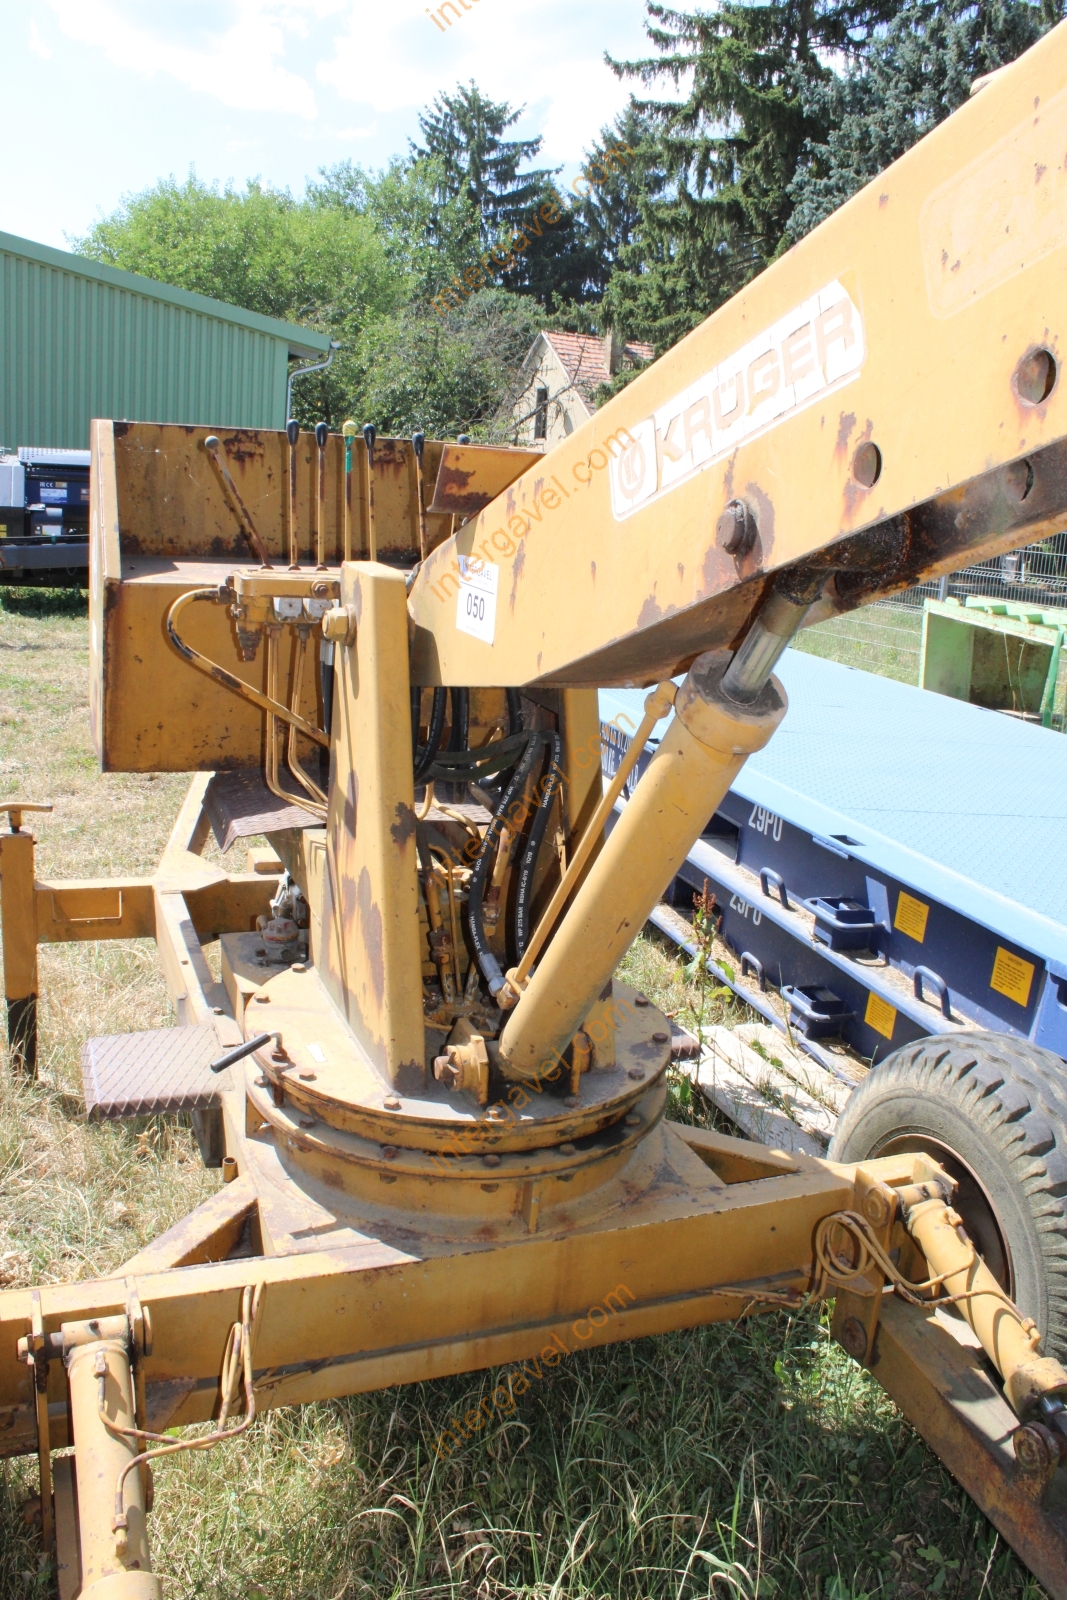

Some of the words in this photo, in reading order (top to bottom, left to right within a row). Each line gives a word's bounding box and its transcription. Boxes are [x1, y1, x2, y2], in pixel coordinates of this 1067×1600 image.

[656, 297, 857, 484] KRÜGER
[466, 592, 485, 621] 050
[470, 915, 482, 950] HANSA-FLEX
